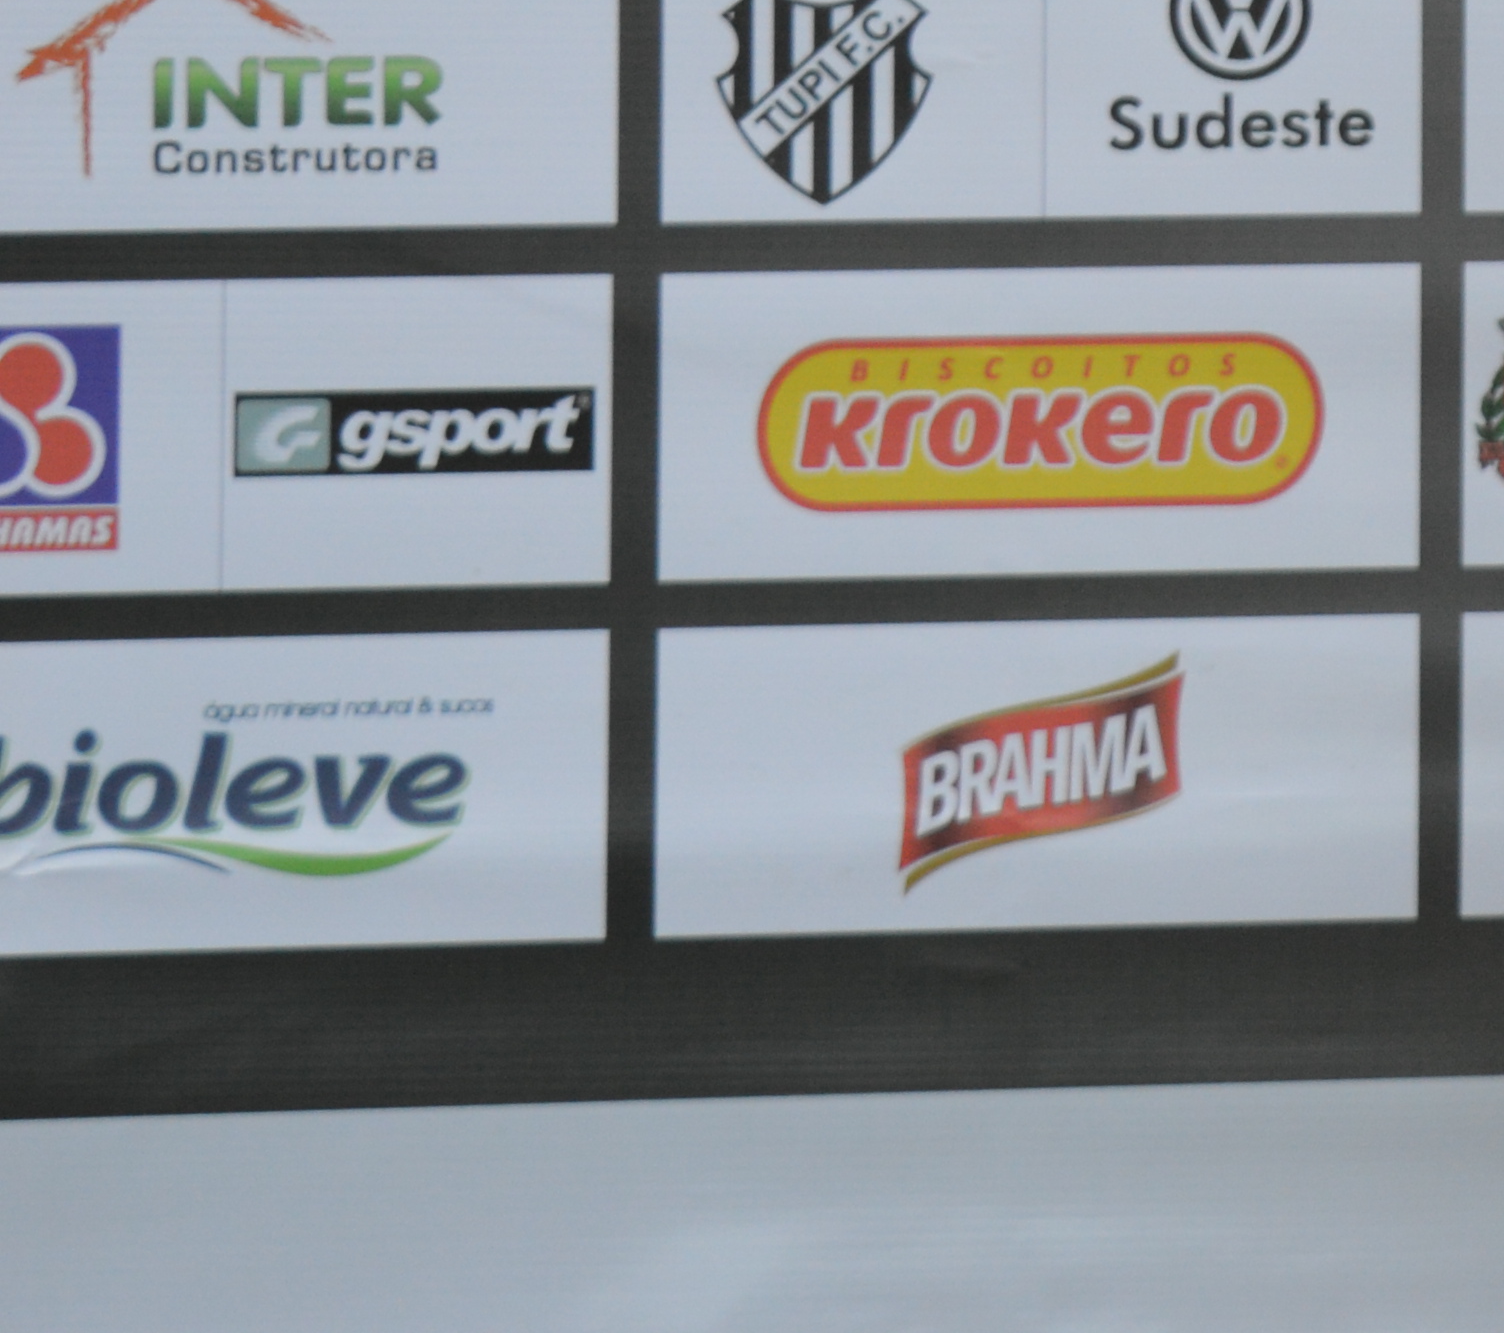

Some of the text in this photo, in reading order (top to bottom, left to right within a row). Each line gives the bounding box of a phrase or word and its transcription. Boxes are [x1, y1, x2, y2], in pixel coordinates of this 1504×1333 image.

[152, 56, 441, 130] INTER
[1110, 93, 1374, 151] Sudeste
[152, 140, 437, 175] Construtora
[851, 355, 1237, 383] BISCOITOS
[340, 396, 580, 469] gsport
[915, 699, 1167, 835] BRAHMA
